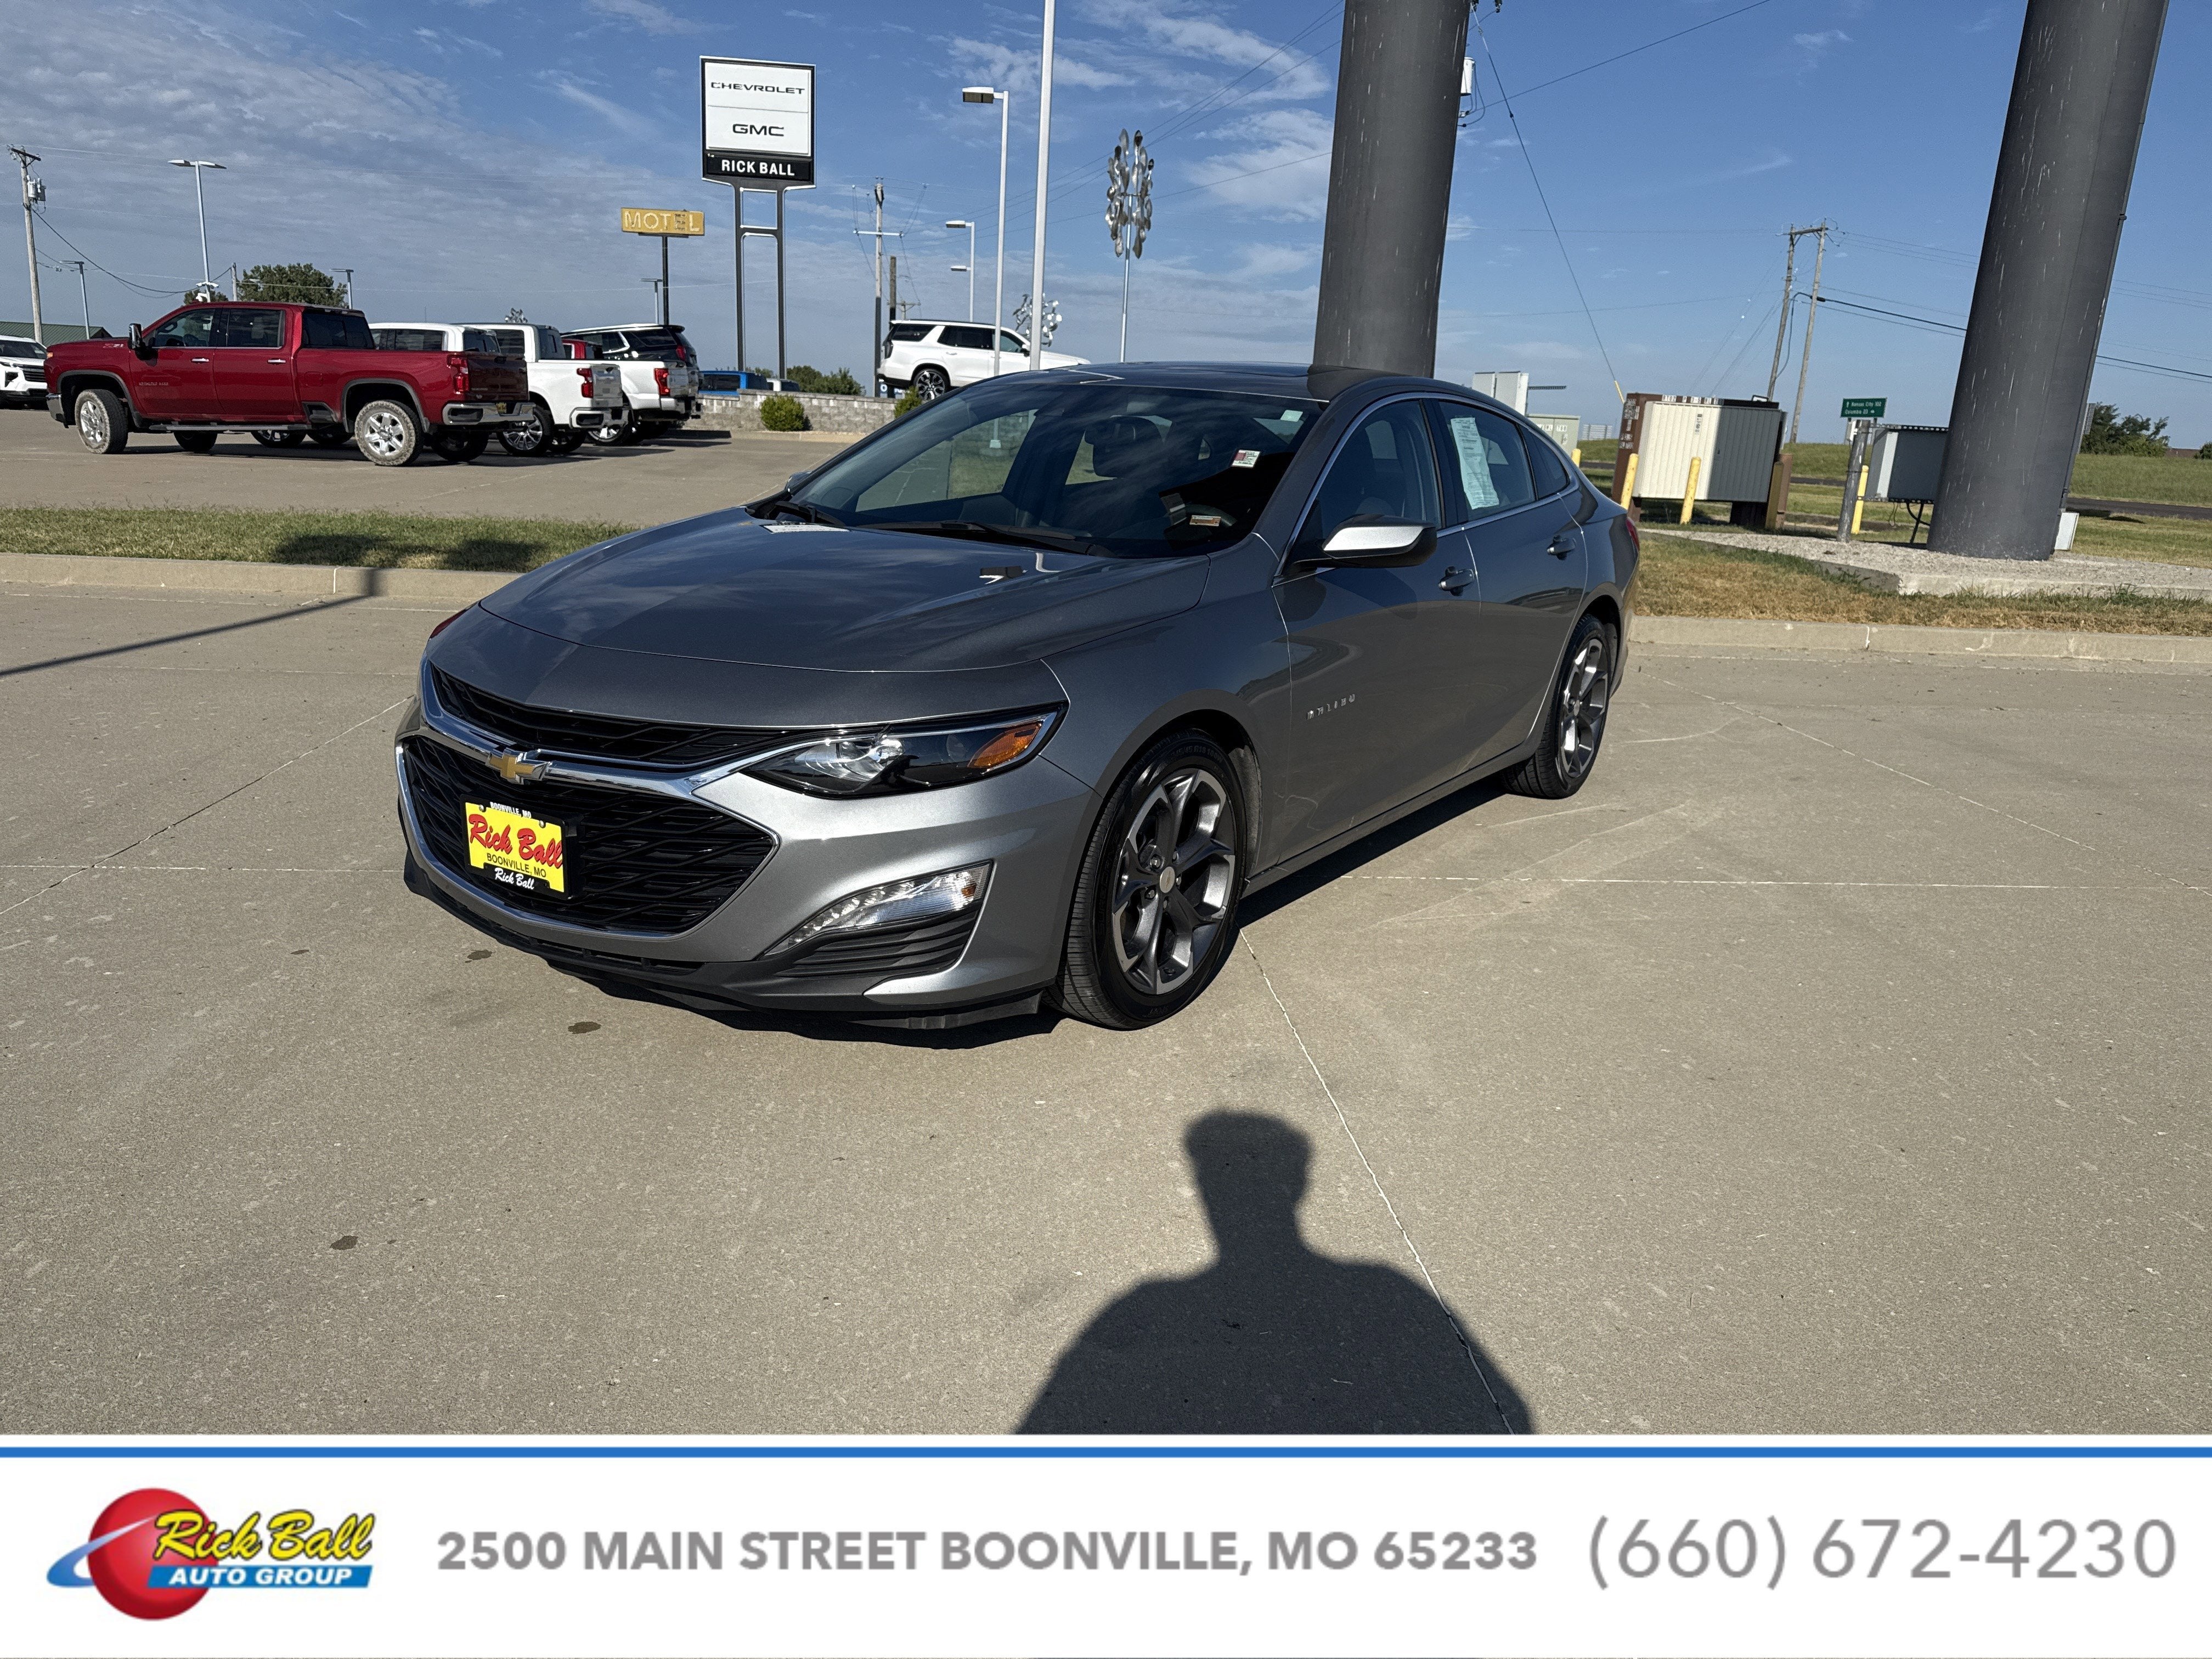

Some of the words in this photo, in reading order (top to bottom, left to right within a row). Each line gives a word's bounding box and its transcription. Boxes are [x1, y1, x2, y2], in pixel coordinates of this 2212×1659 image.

[711, 82, 805, 94] CHEVROLET
[732, 123, 785, 137] GMC
[721, 159, 755, 173] RICK
[759, 162, 795, 176] BALL
[624, 211, 700, 232] MOTEL
[1307, 693, 1356, 720] MALIBU
[490, 802, 521, 816] BOONVILLE,
[522, 810, 532, 819] MO
[469, 814, 513, 855] Rick
[517, 828, 563, 870] Ball
[487, 853, 532, 875] BOONVILLE,
[534, 866, 546, 878] MO
[494, 867, 515, 885] Rick
[515, 873, 535, 890] Ball
